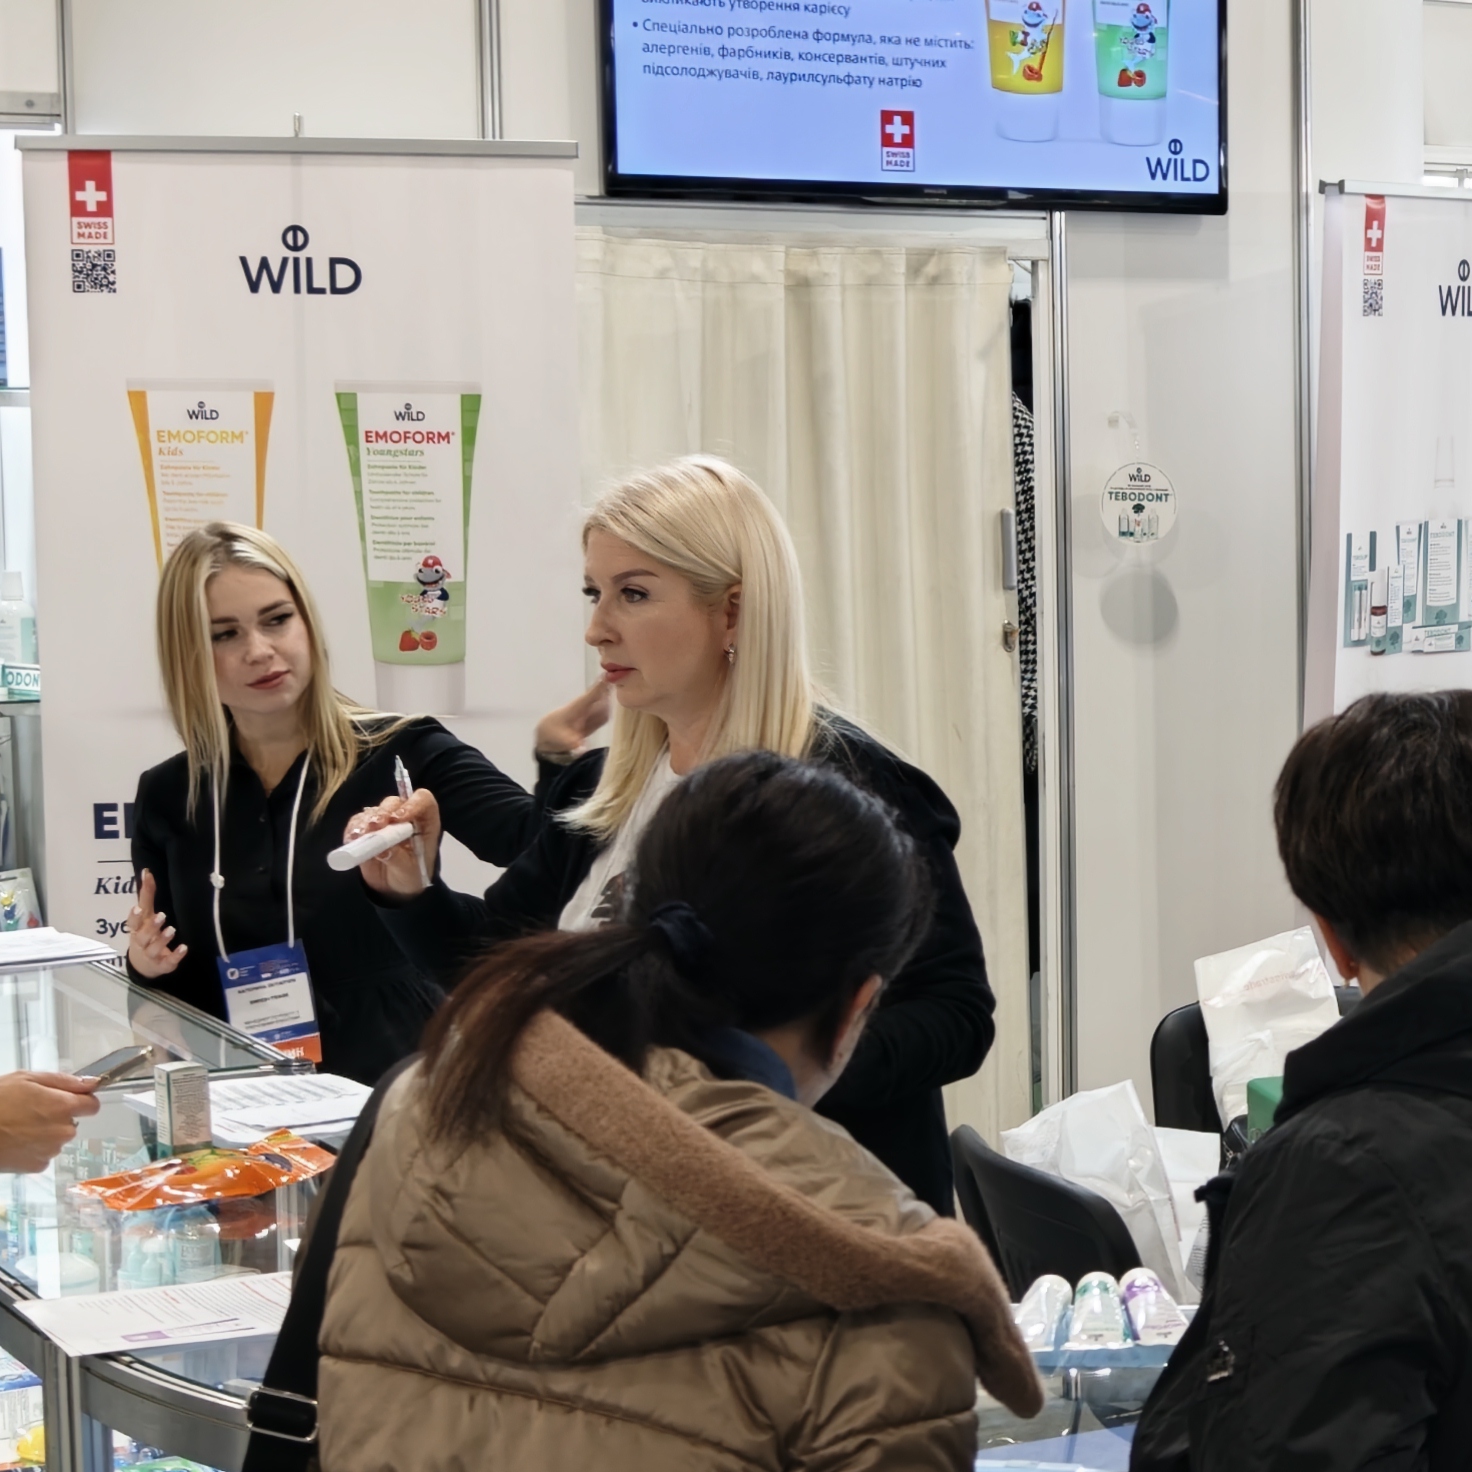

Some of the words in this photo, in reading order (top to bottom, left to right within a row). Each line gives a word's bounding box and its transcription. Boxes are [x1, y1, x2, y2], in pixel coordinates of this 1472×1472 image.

[729, 0, 800, 13] утворення
[642, 19, 723, 35] Спеціально
[727, 25, 809, 40] розроблена
[813, 30, 876, 46] формула,
[879, 36, 901, 46] яка
[905, 37, 920, 47] не
[642, 41, 715, 57] алергенів,
[718, 44, 794, 62] фарбників,
[798, 51, 889, 67] консервантів,
[892, 57, 946, 69] штучних
[643, 63, 763, 81] підсолоджувачів,
[766, 70, 875, 88] лаурилсульфату
[878, 75, 923, 90] натрію
[1146, 157, 1209, 182] WILD
[77, 221, 109, 230] SWISS
[77, 231, 109, 240] MADE
[239, 256, 362, 295] WILD
[187, 409, 220, 420] WILD
[394, 410, 425, 422] WILD
[158, 447, 184, 456] Kids
[1128, 474, 1151, 483] WILD
[1108, 491, 1169, 503] TEBODONT
